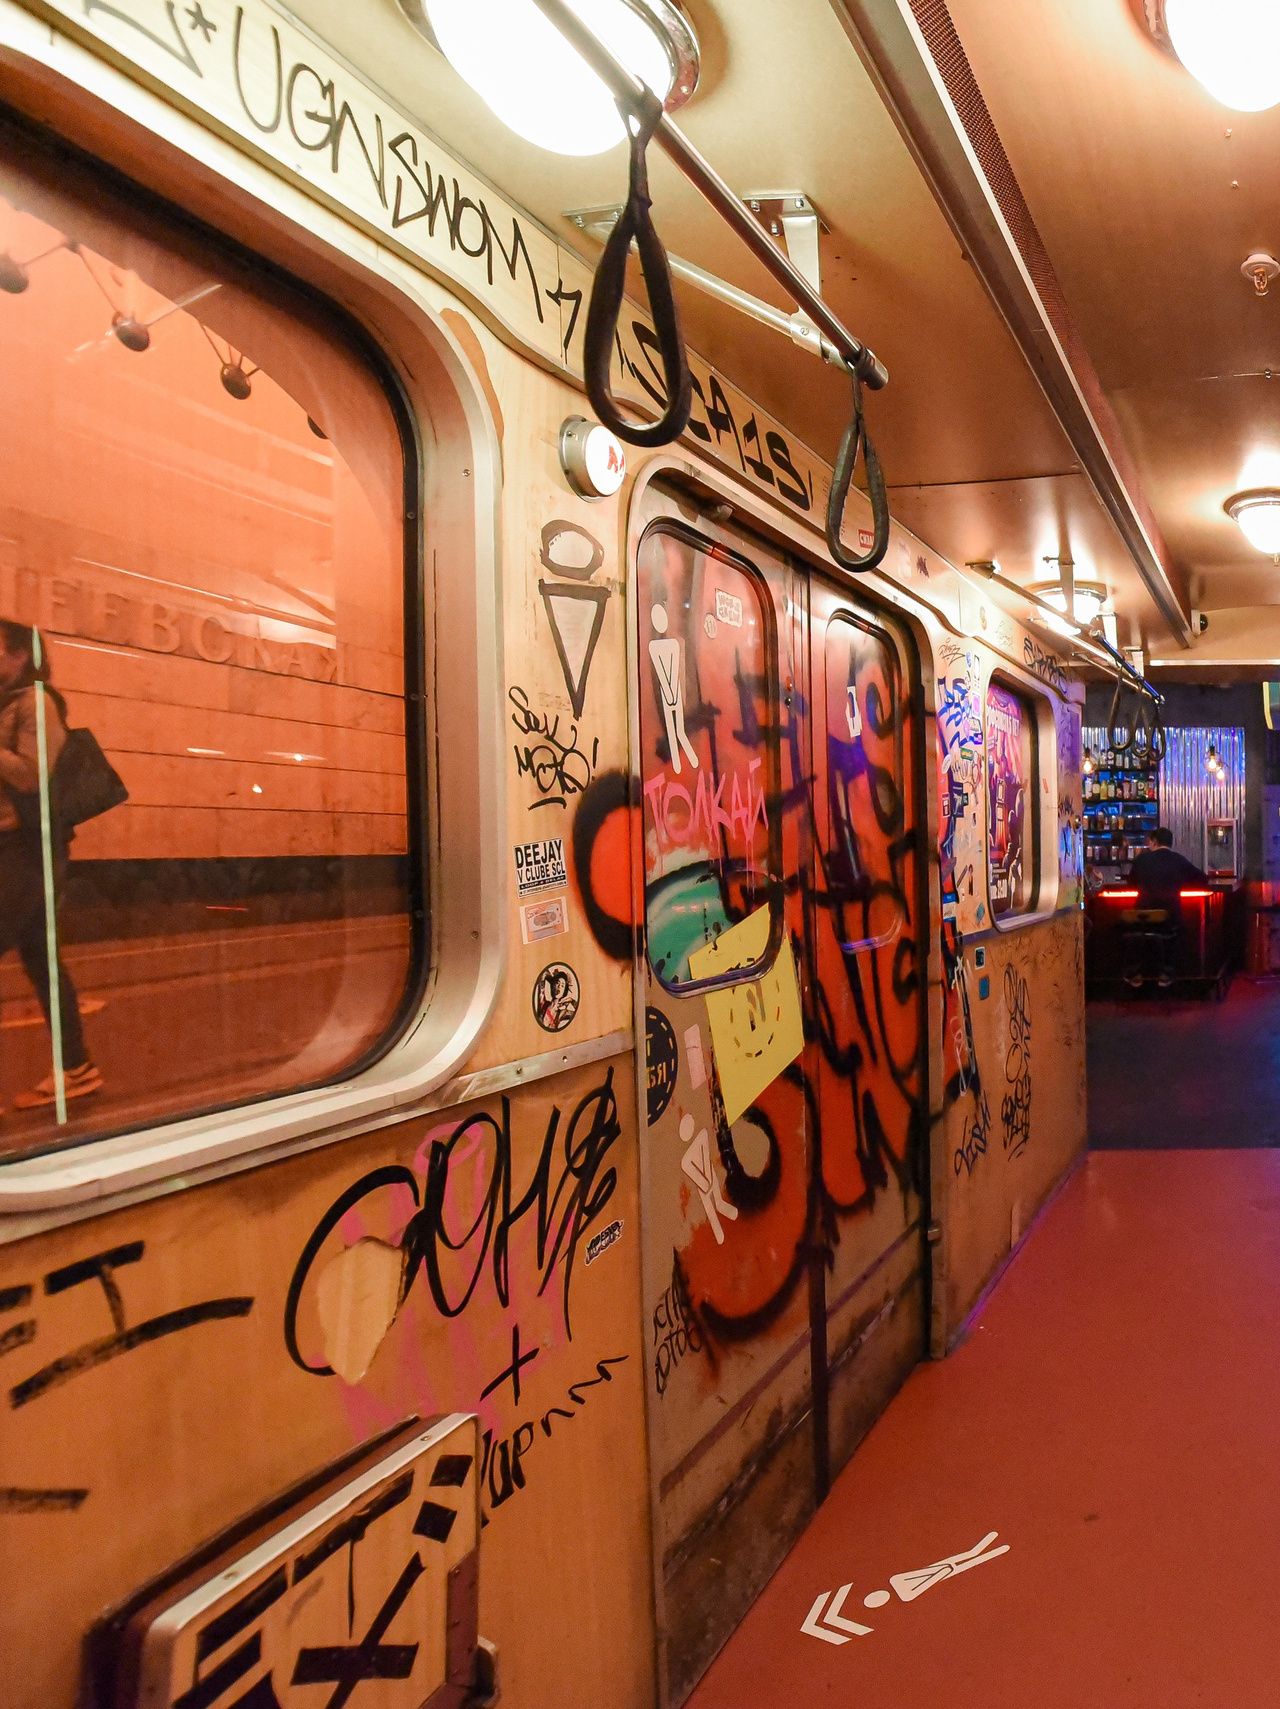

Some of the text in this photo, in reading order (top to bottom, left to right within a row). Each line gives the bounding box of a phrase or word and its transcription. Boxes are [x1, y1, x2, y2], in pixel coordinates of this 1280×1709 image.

[515, 840, 562, 868] DEEJAY
[525, 864, 551, 882] CLUBE
[551, 860, 566, 878] SCL
